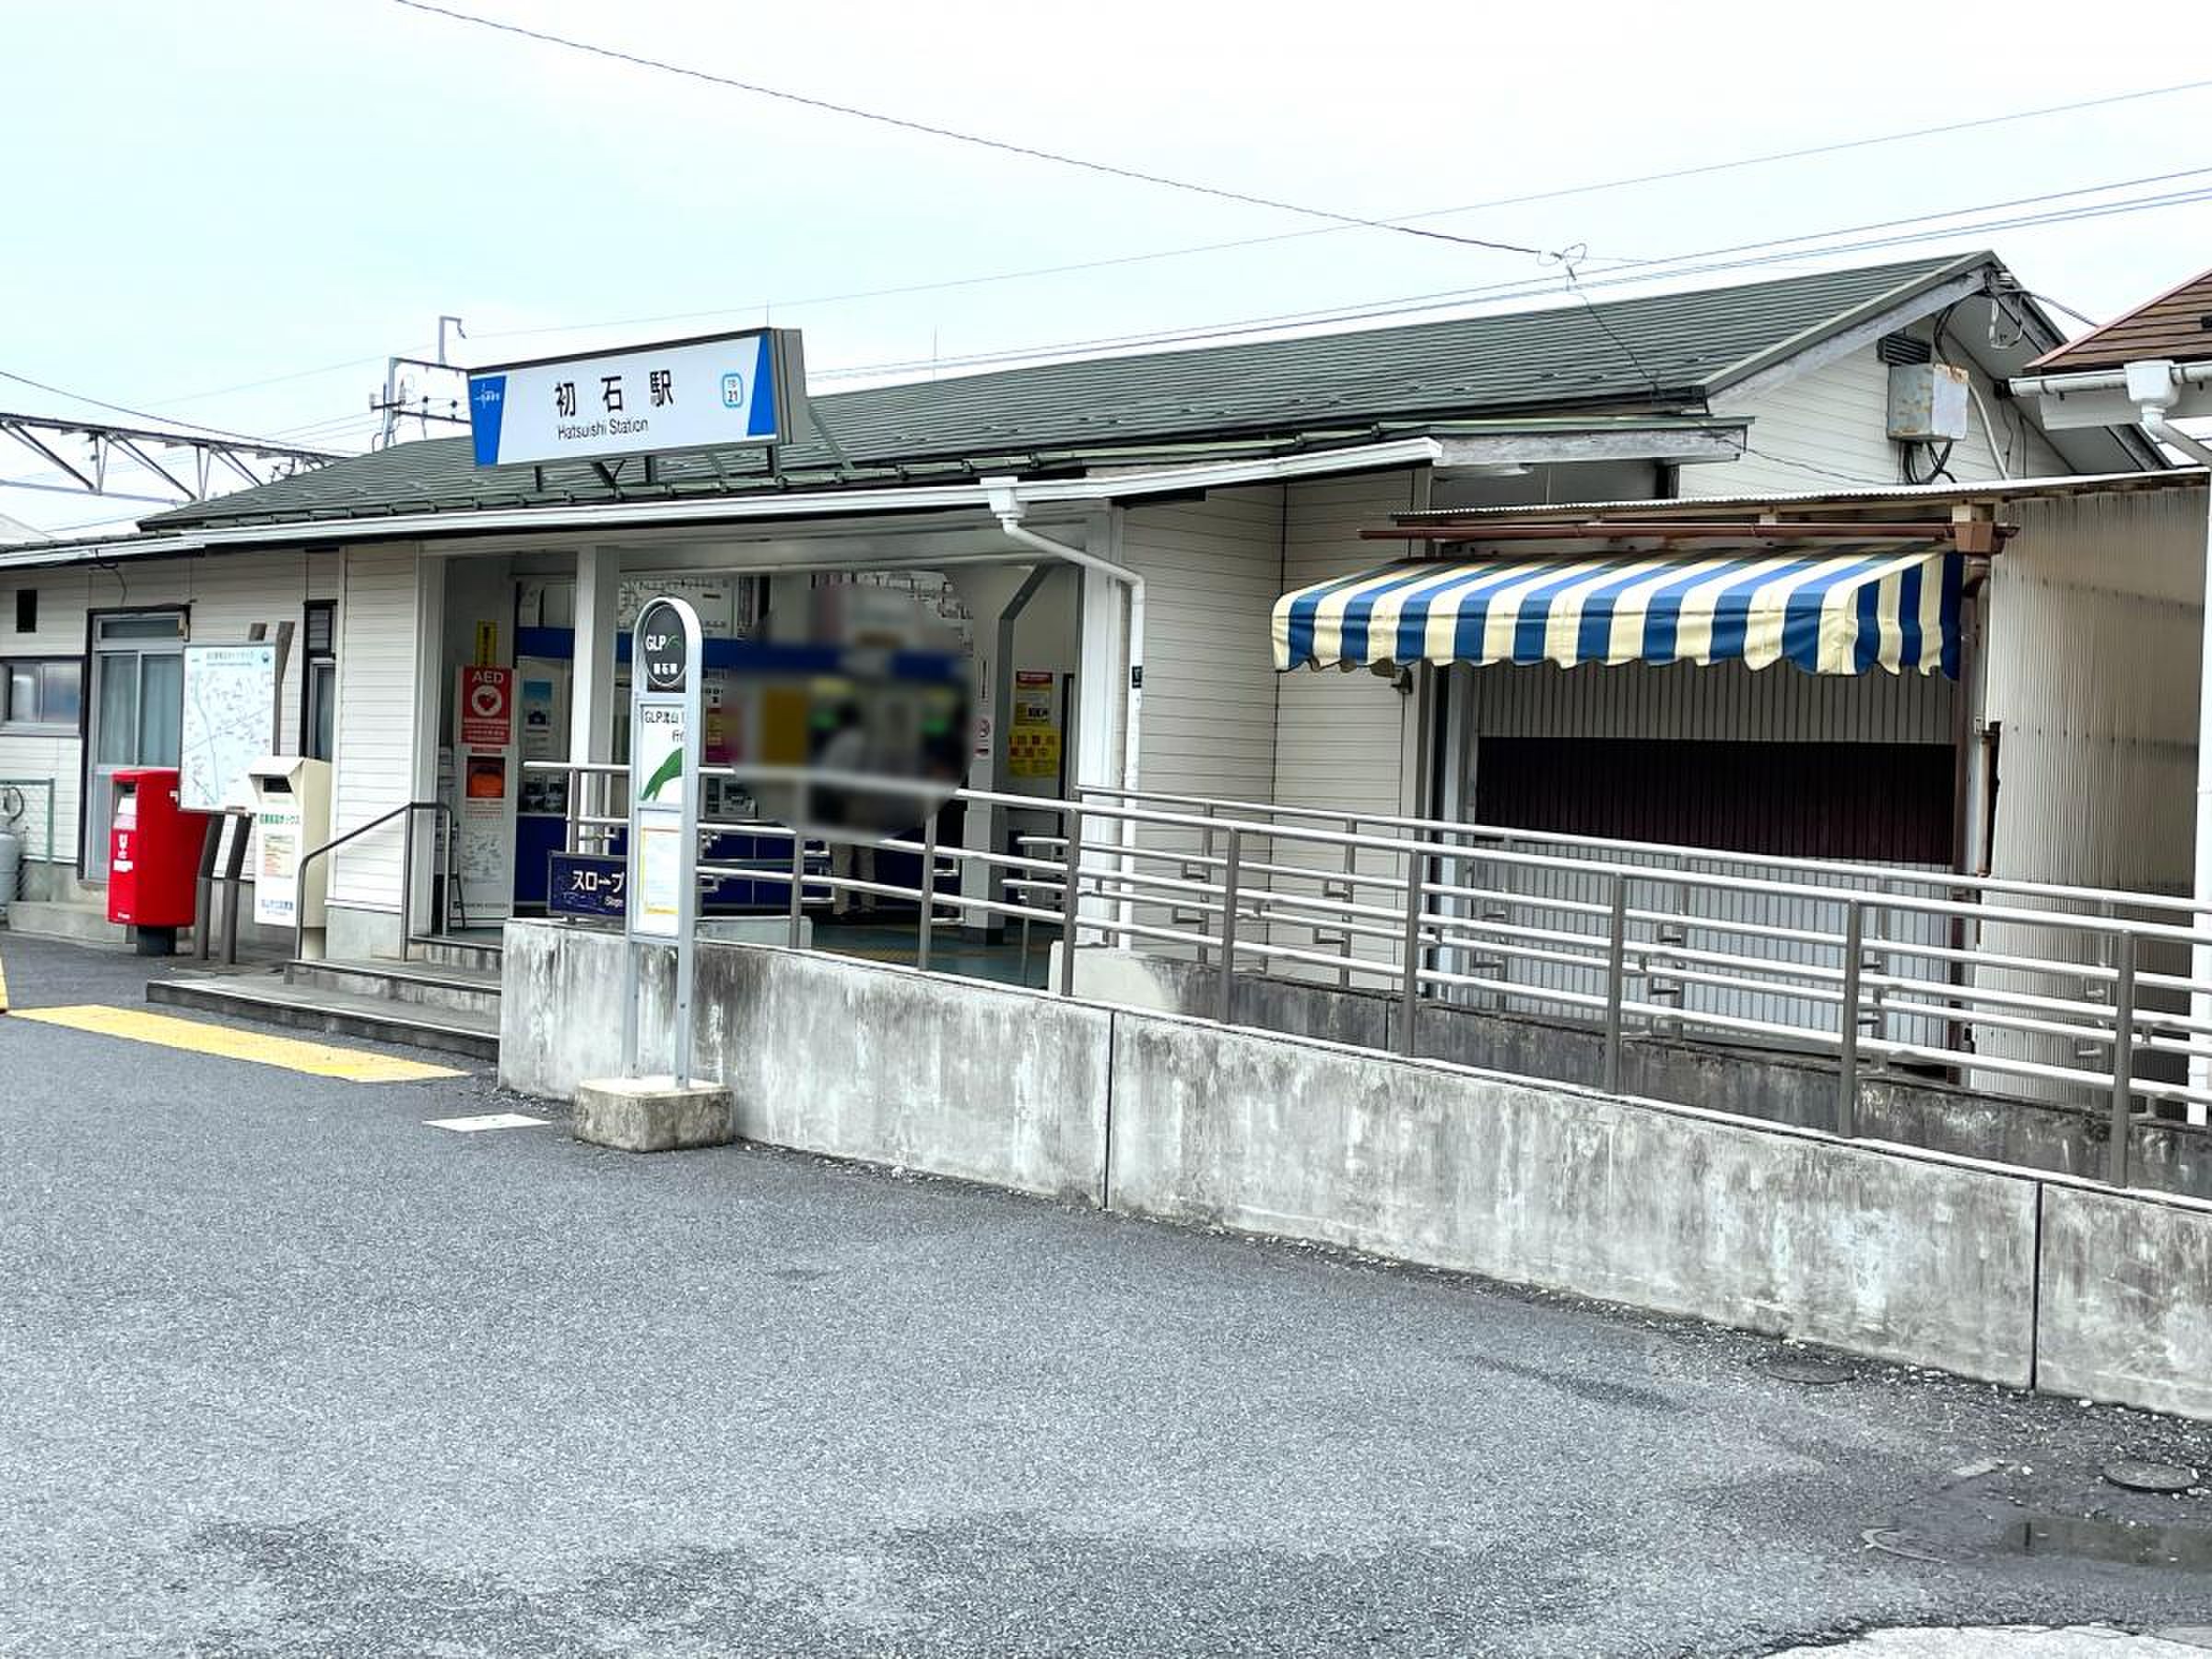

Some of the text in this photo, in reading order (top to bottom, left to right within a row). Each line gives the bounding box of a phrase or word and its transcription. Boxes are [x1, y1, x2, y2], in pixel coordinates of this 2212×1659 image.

[555, 370, 674, 418] 初石駅
[558, 418, 649, 440] Hatsuishi Station
[646, 634, 666, 651] GLP
[472, 671, 503, 684] AED
[571, 869, 625, 893] スロープ
